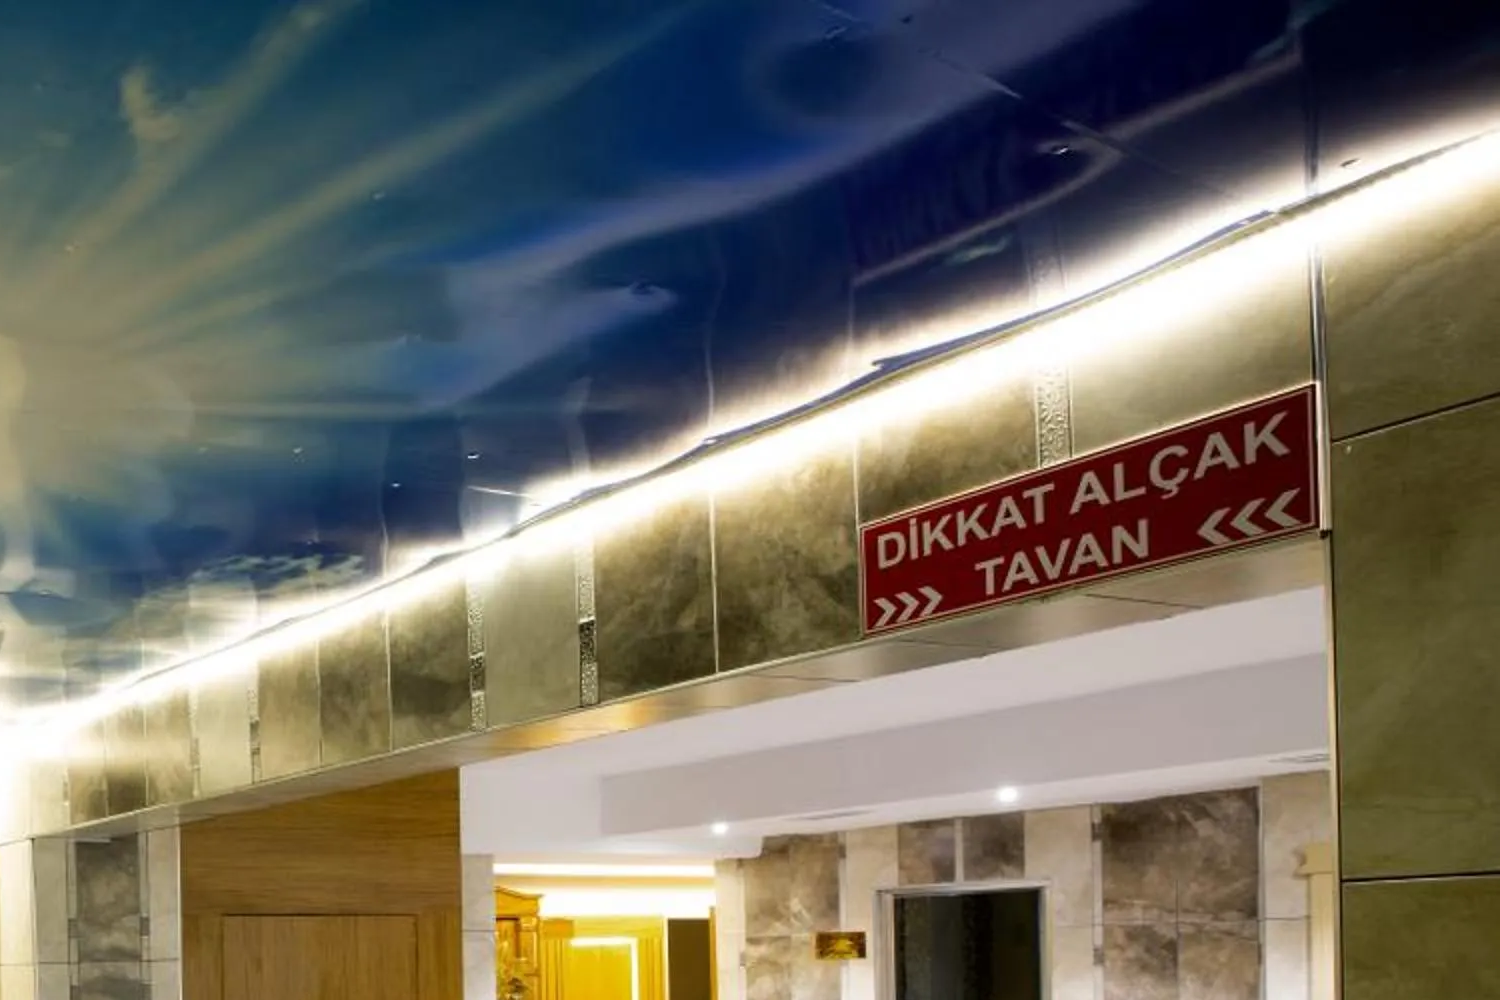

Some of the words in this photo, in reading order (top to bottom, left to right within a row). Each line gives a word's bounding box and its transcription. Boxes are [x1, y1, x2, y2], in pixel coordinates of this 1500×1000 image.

[877, 483, 1055, 570] DİKKAT
[1069, 411, 1291, 514] ALÇAK
[975, 518, 1150, 596] TAVAN
